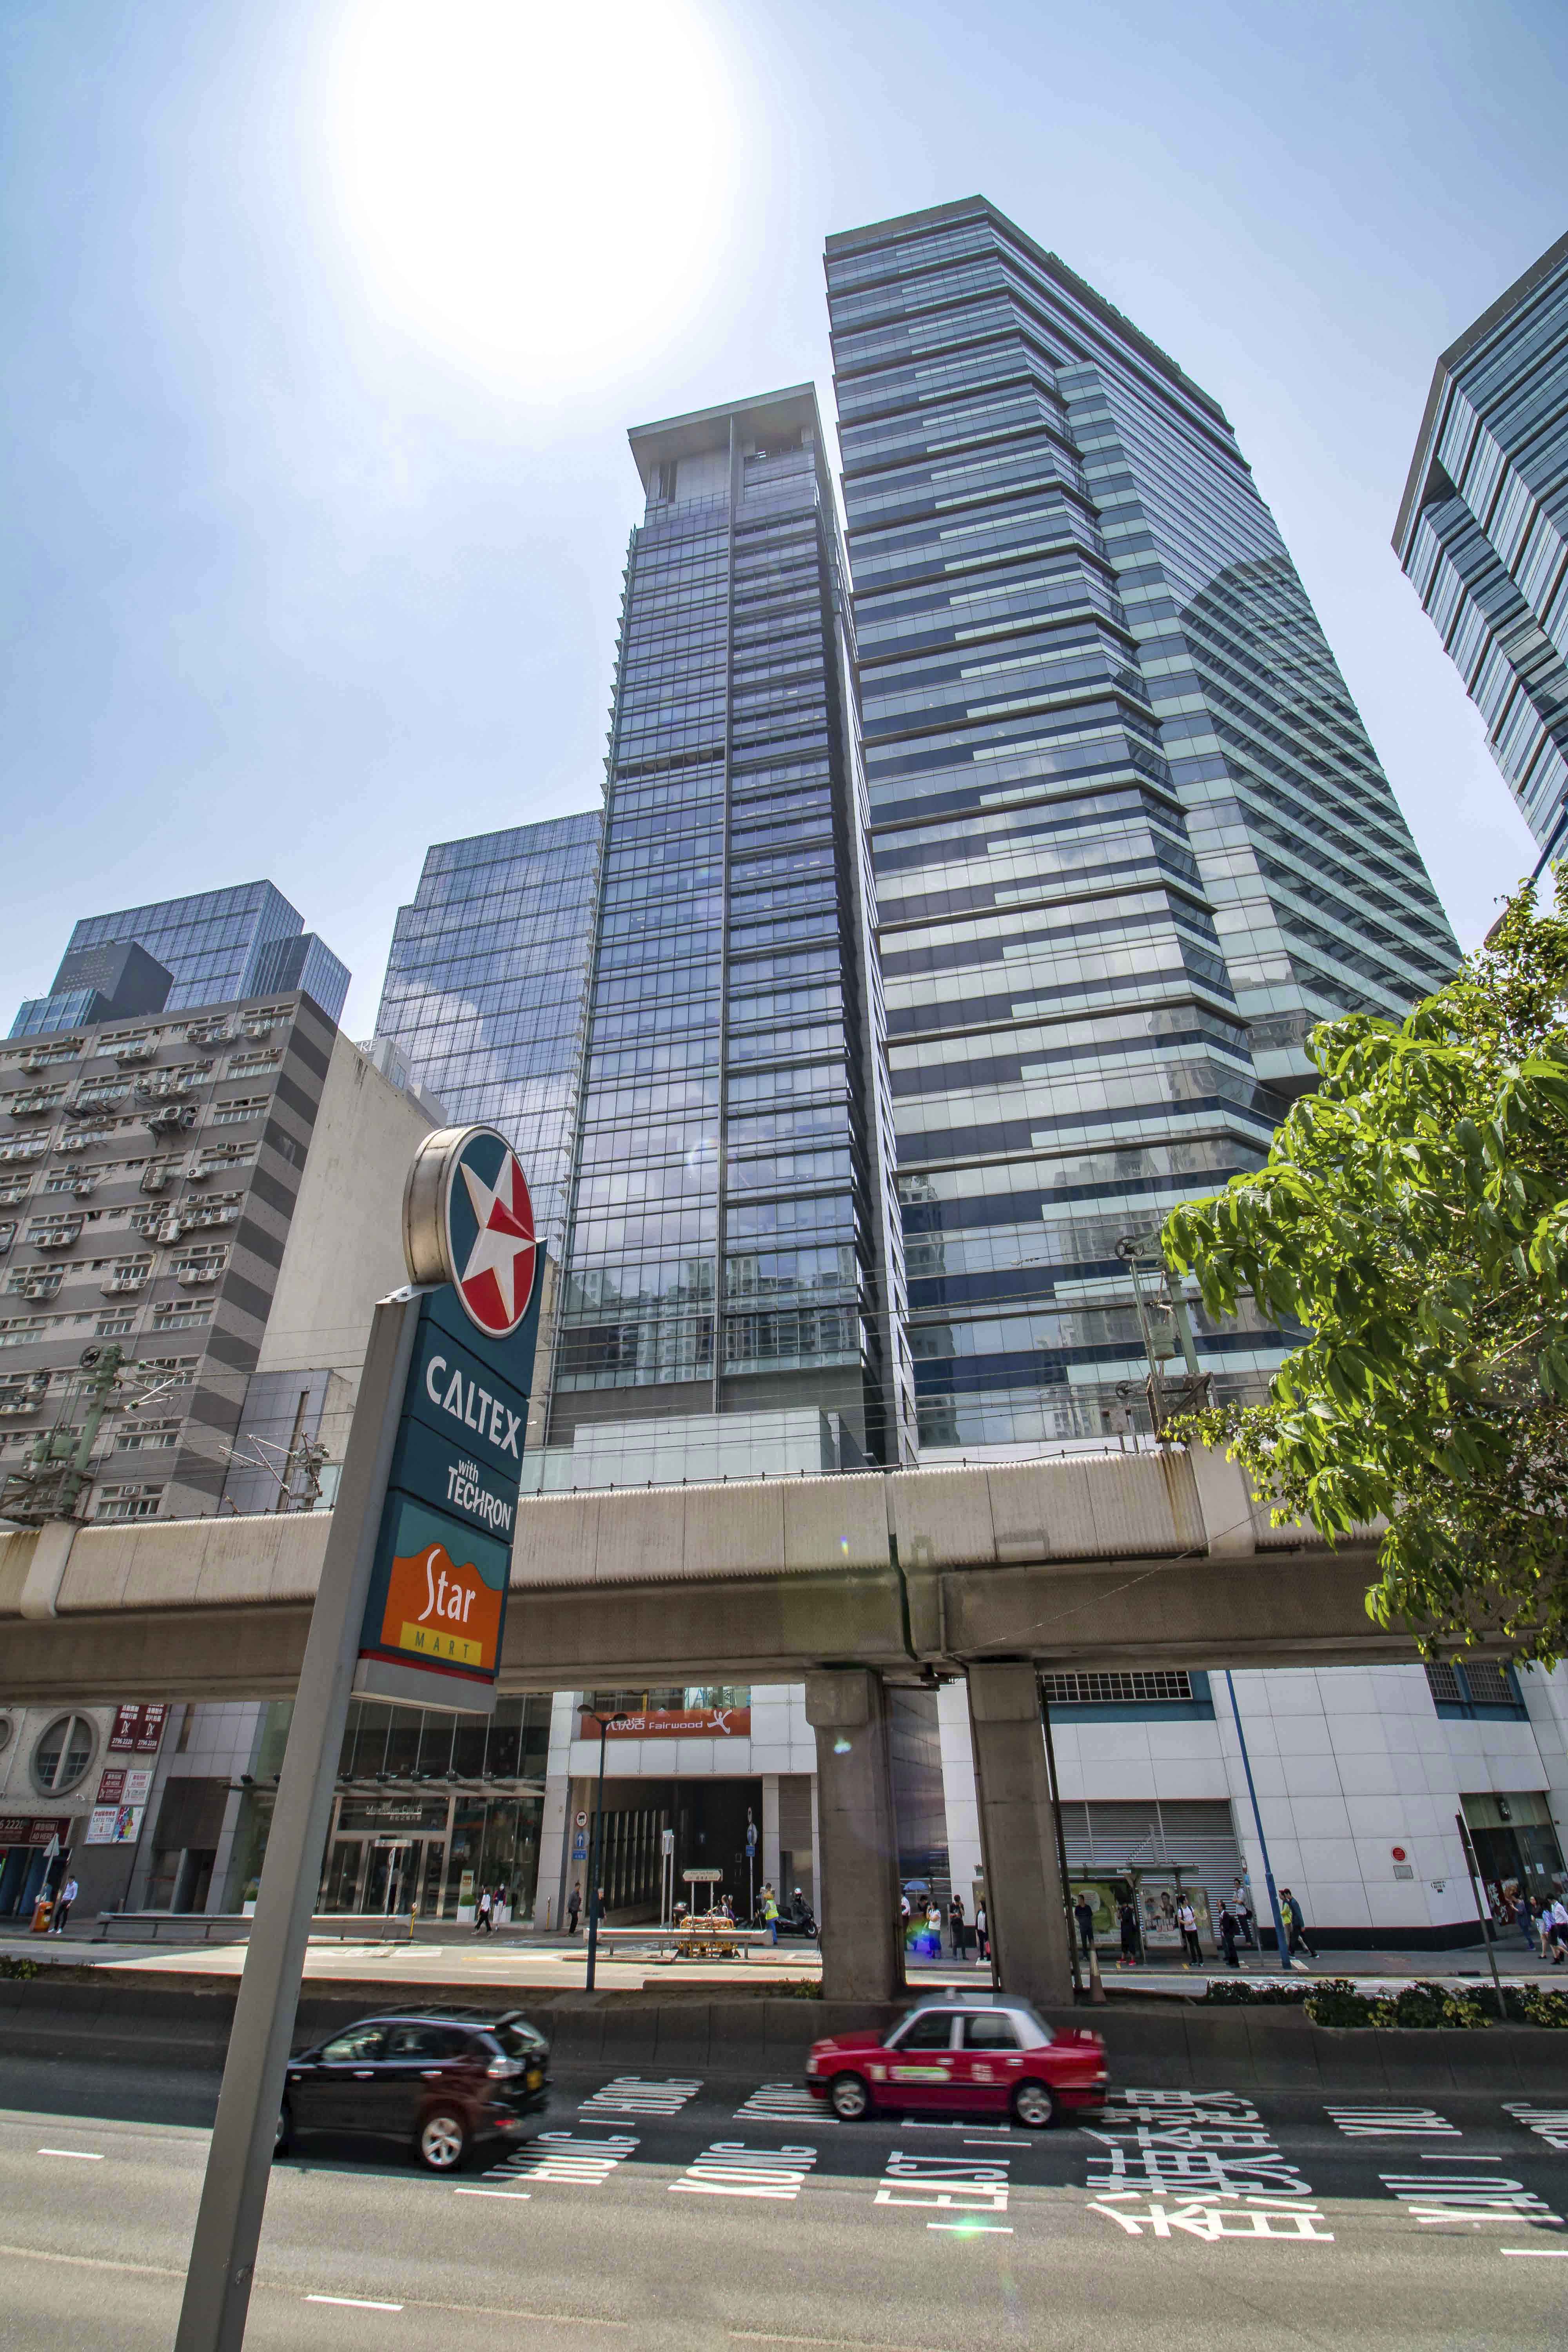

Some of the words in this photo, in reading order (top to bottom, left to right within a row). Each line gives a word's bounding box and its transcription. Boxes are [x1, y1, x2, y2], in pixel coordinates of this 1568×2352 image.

[426, 1356, 521, 1459] CALTEX
[447, 1466, 512, 1530] TECHRON
[459, 1460, 479, 1483] with
[418, 1549, 476, 1622] Star
[415, 1631, 470, 1659] MART
[649, 1721, 702, 1730] Fairwood
[577, 2076, 704, 2116] HONG
[1323, 2106, 1463, 2136] YAU
[482, 2131, 641, 2185] HONG
[667, 2142, 817, 2201] KONG
[873, 2151, 1011, 2211] EAST
[1085, 2149, 1335, 2241] 香港東
[1378, 2174, 1566, 2224] YAU
